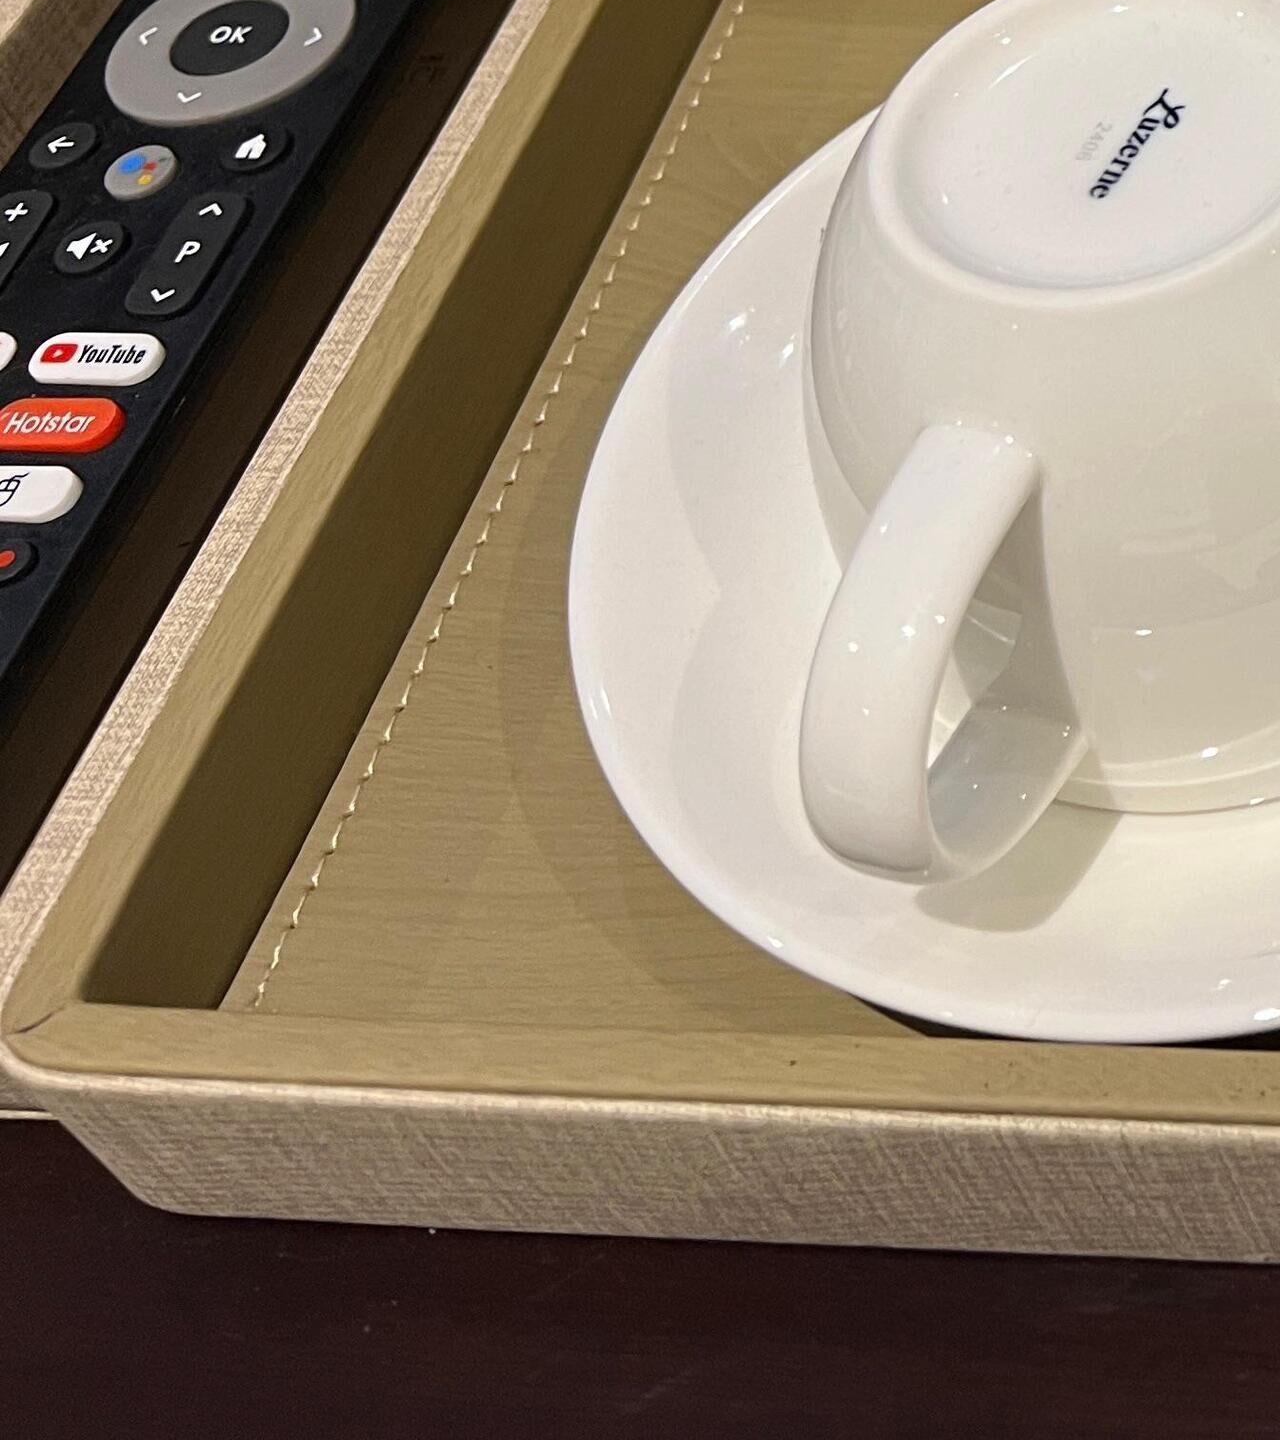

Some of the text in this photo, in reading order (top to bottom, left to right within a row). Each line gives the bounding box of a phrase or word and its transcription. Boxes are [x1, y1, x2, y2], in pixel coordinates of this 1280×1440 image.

[208, 23, 252, 46] OK
[1088, 87, 1186, 199] Luzerne
[174, 240, 201, 263] P
[77, 343, 146, 365] YouTube
[3, 410, 96, 435] Hotstar
